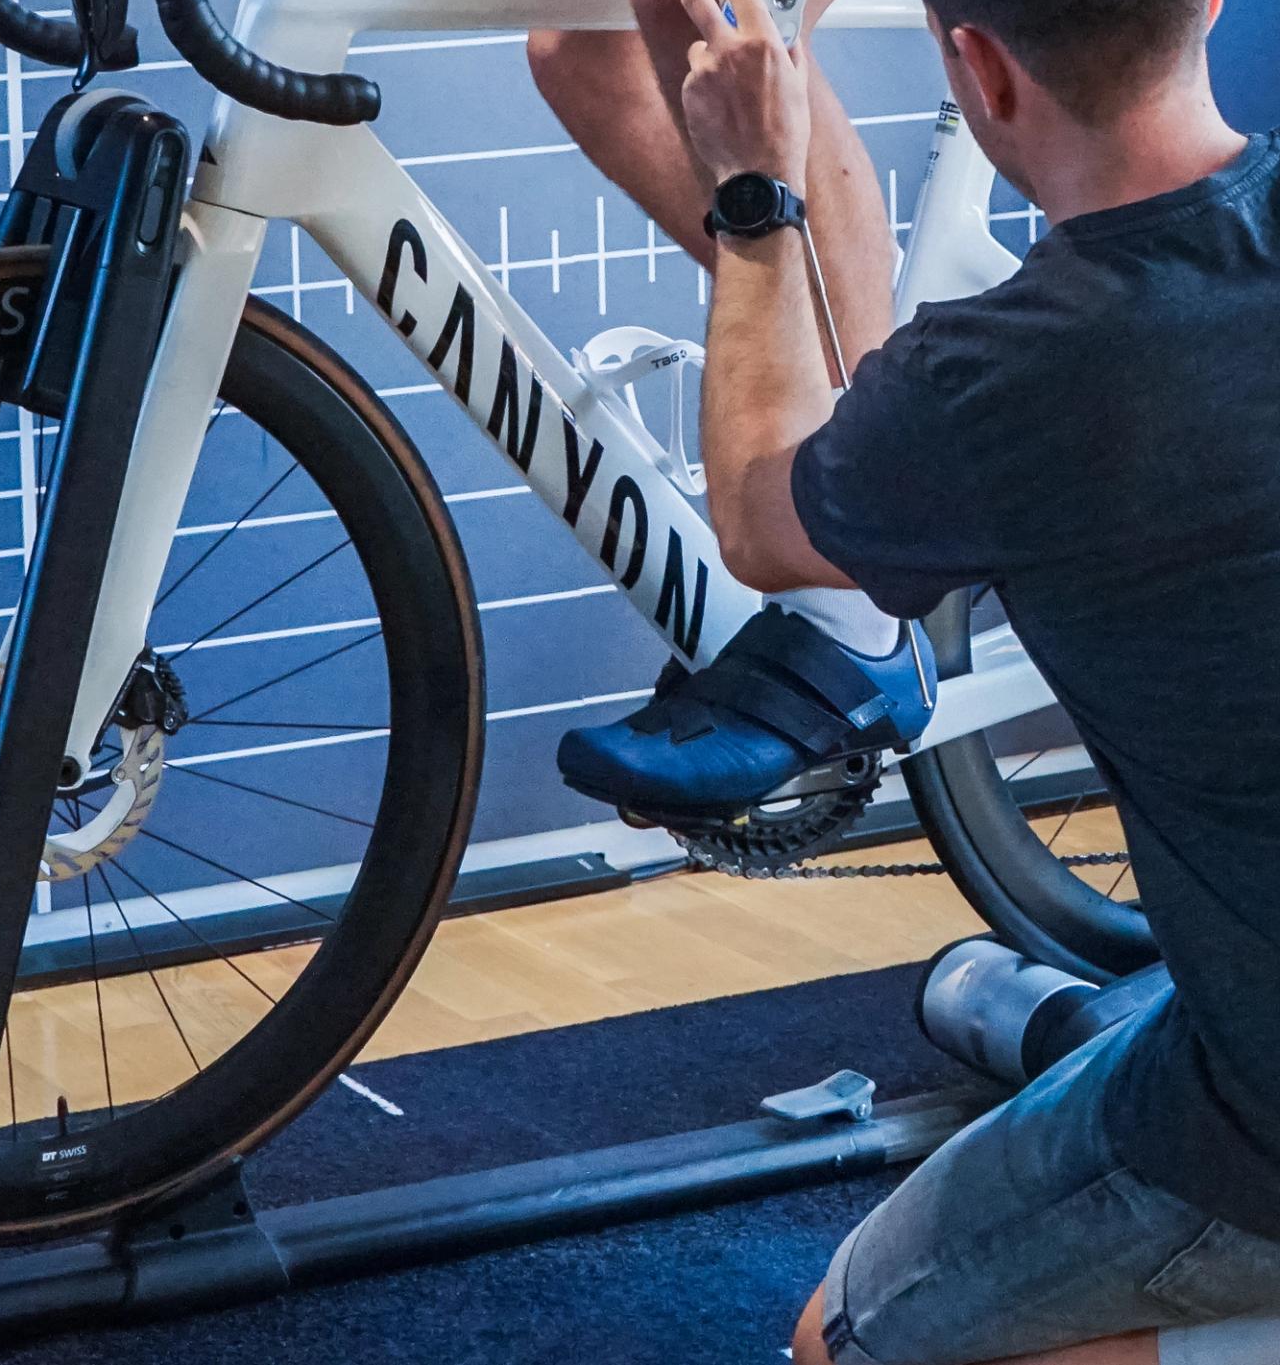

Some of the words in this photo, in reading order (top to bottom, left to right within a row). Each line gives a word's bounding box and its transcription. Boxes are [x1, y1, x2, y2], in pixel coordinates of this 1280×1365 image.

[376, 218, 708, 660] CANYON
[41, 1151, 58, 1162] DT
[58, 1144, 88, 1160] SWISS
